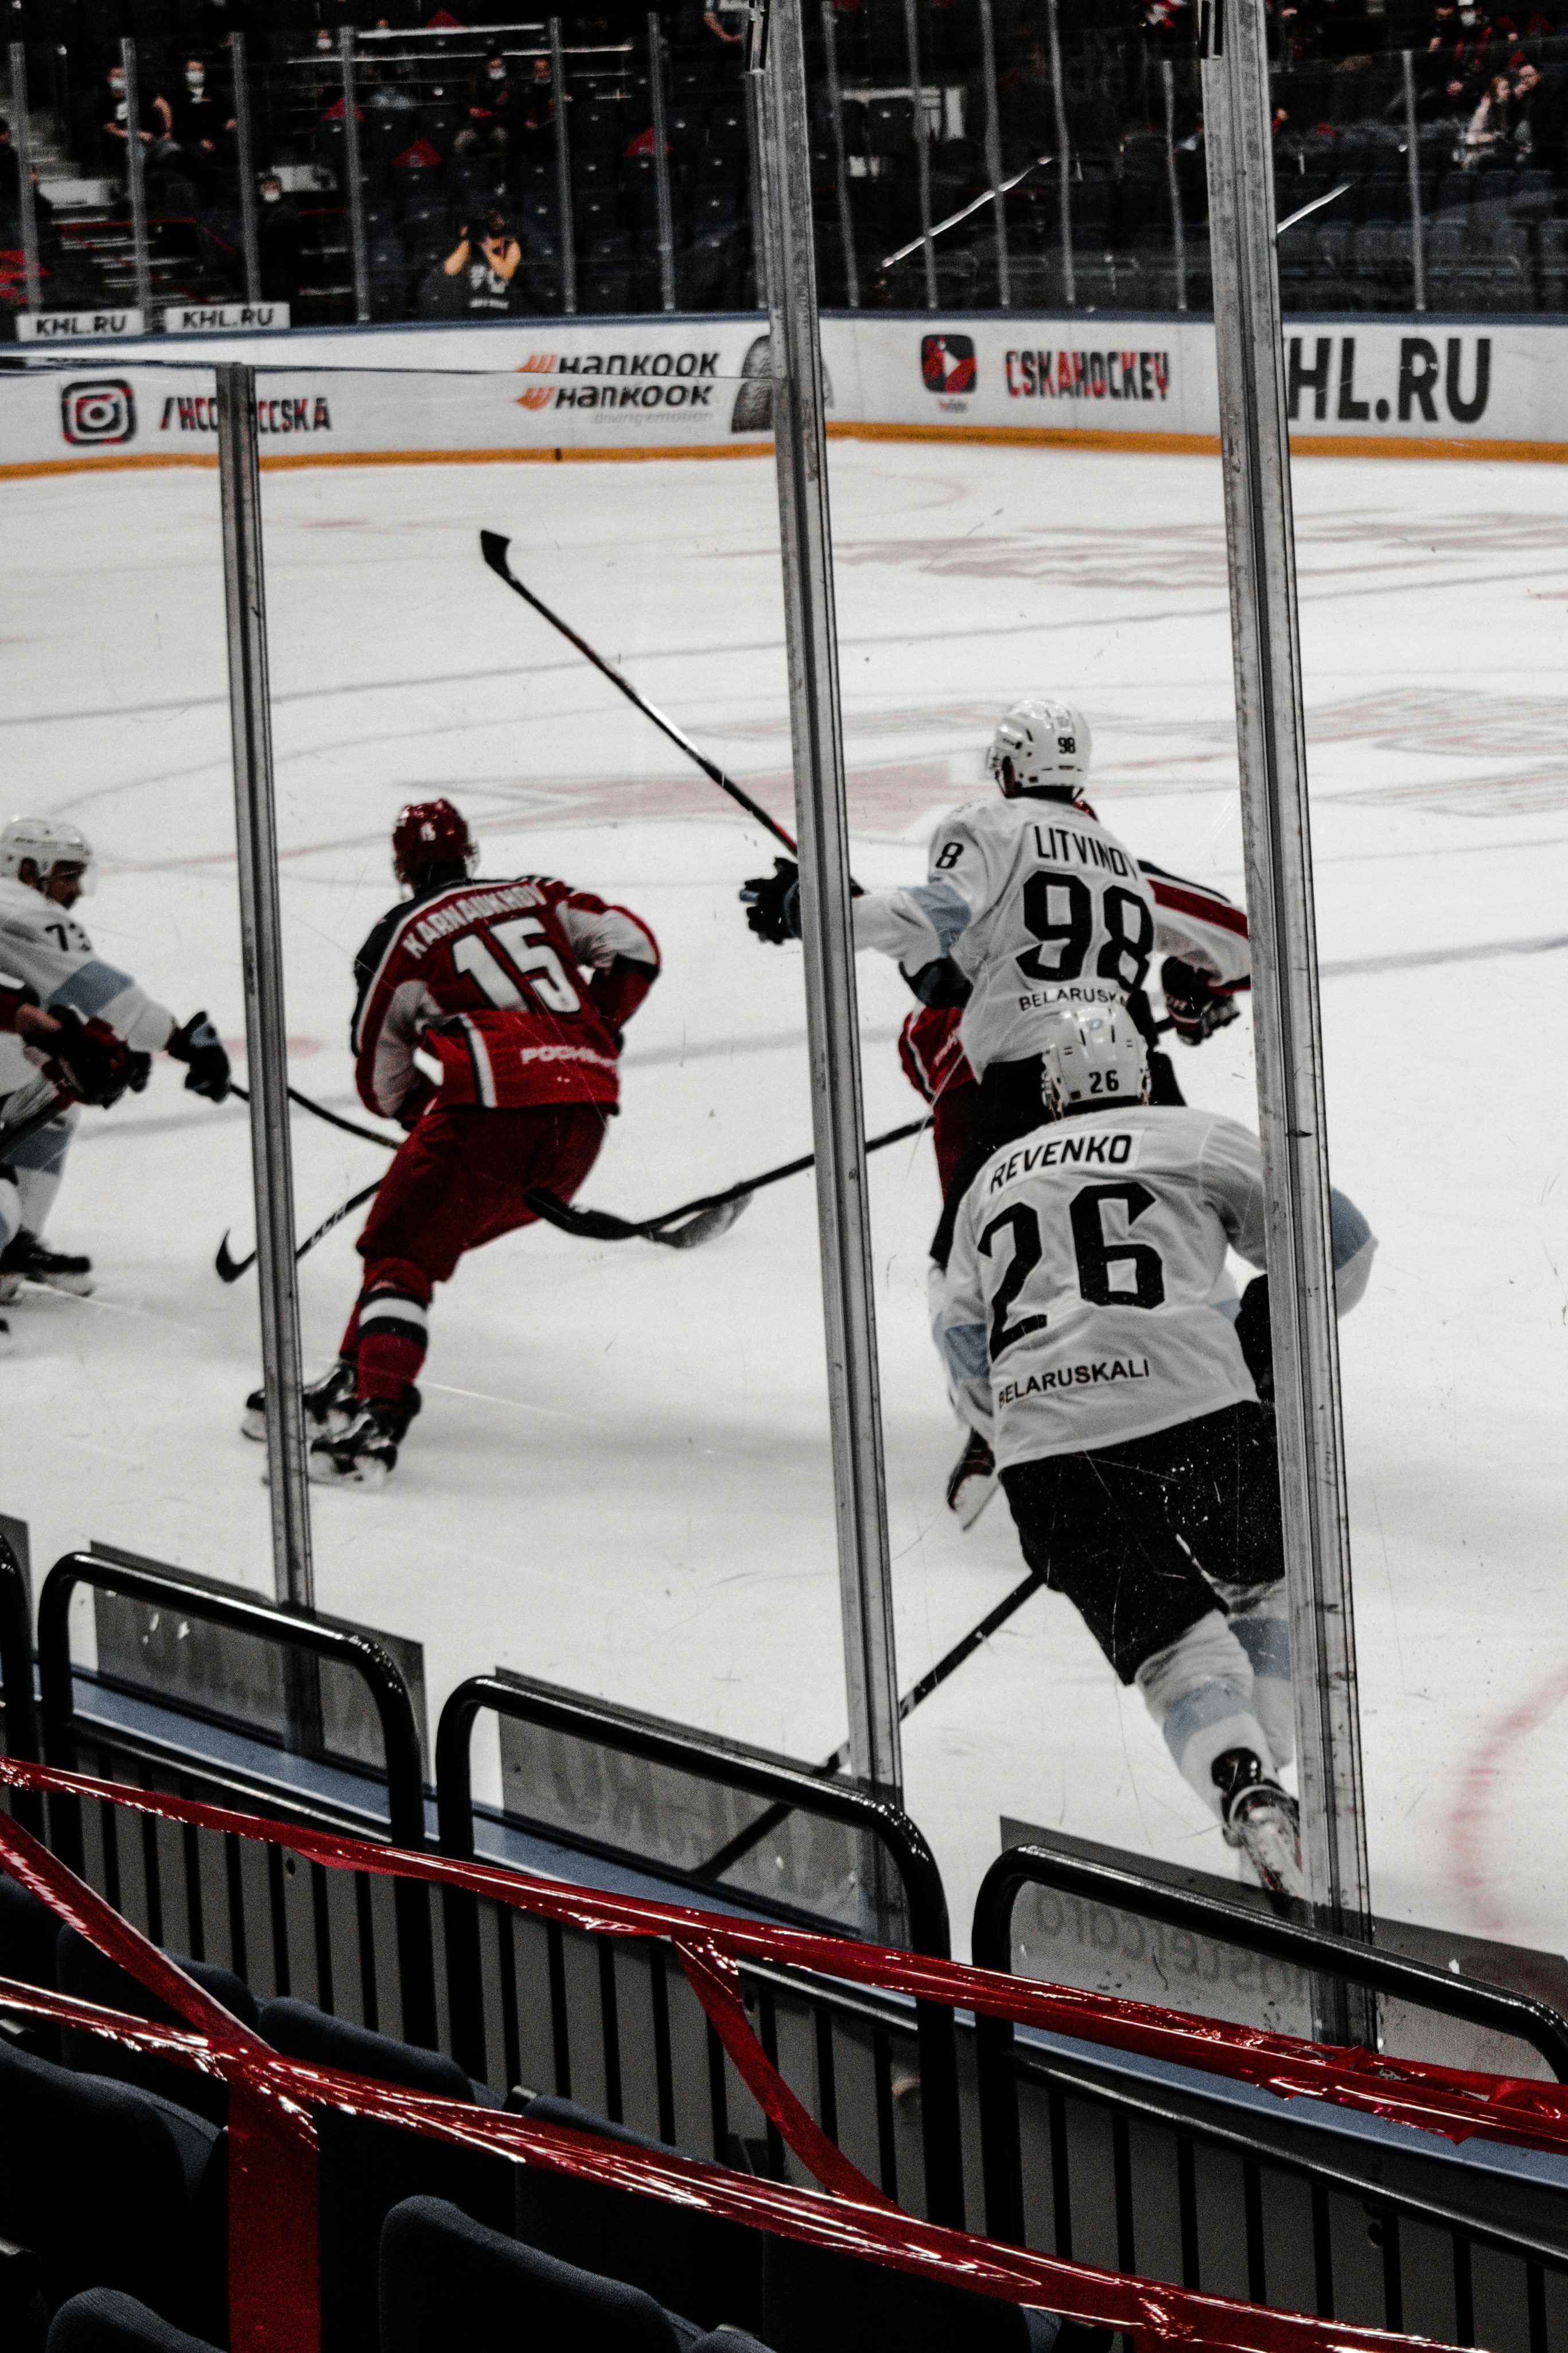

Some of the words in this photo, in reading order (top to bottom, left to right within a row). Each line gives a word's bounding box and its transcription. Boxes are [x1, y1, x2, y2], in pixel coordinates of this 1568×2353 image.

[36, 315, 127, 335] KHL.RU
[182, 309, 275, 329] KHL.RU
[1005, 350, 1169, 400] CSKAHOCKEY
[1283, 337, 1492, 423] HL.RU
[1057, 737, 1076, 754] 98
[1015, 870, 1154, 993] 98
[450, 917, 581, 1014] 15
[1019, 987, 1130, 1012] BELARUSK
[1088, 1069, 1119, 1094] 26
[990, 1133, 1133, 1195] REVENKO
[976, 1182, 1166, 1364] 26
[998, 1358, 1150, 1409] BELARUSKALI
